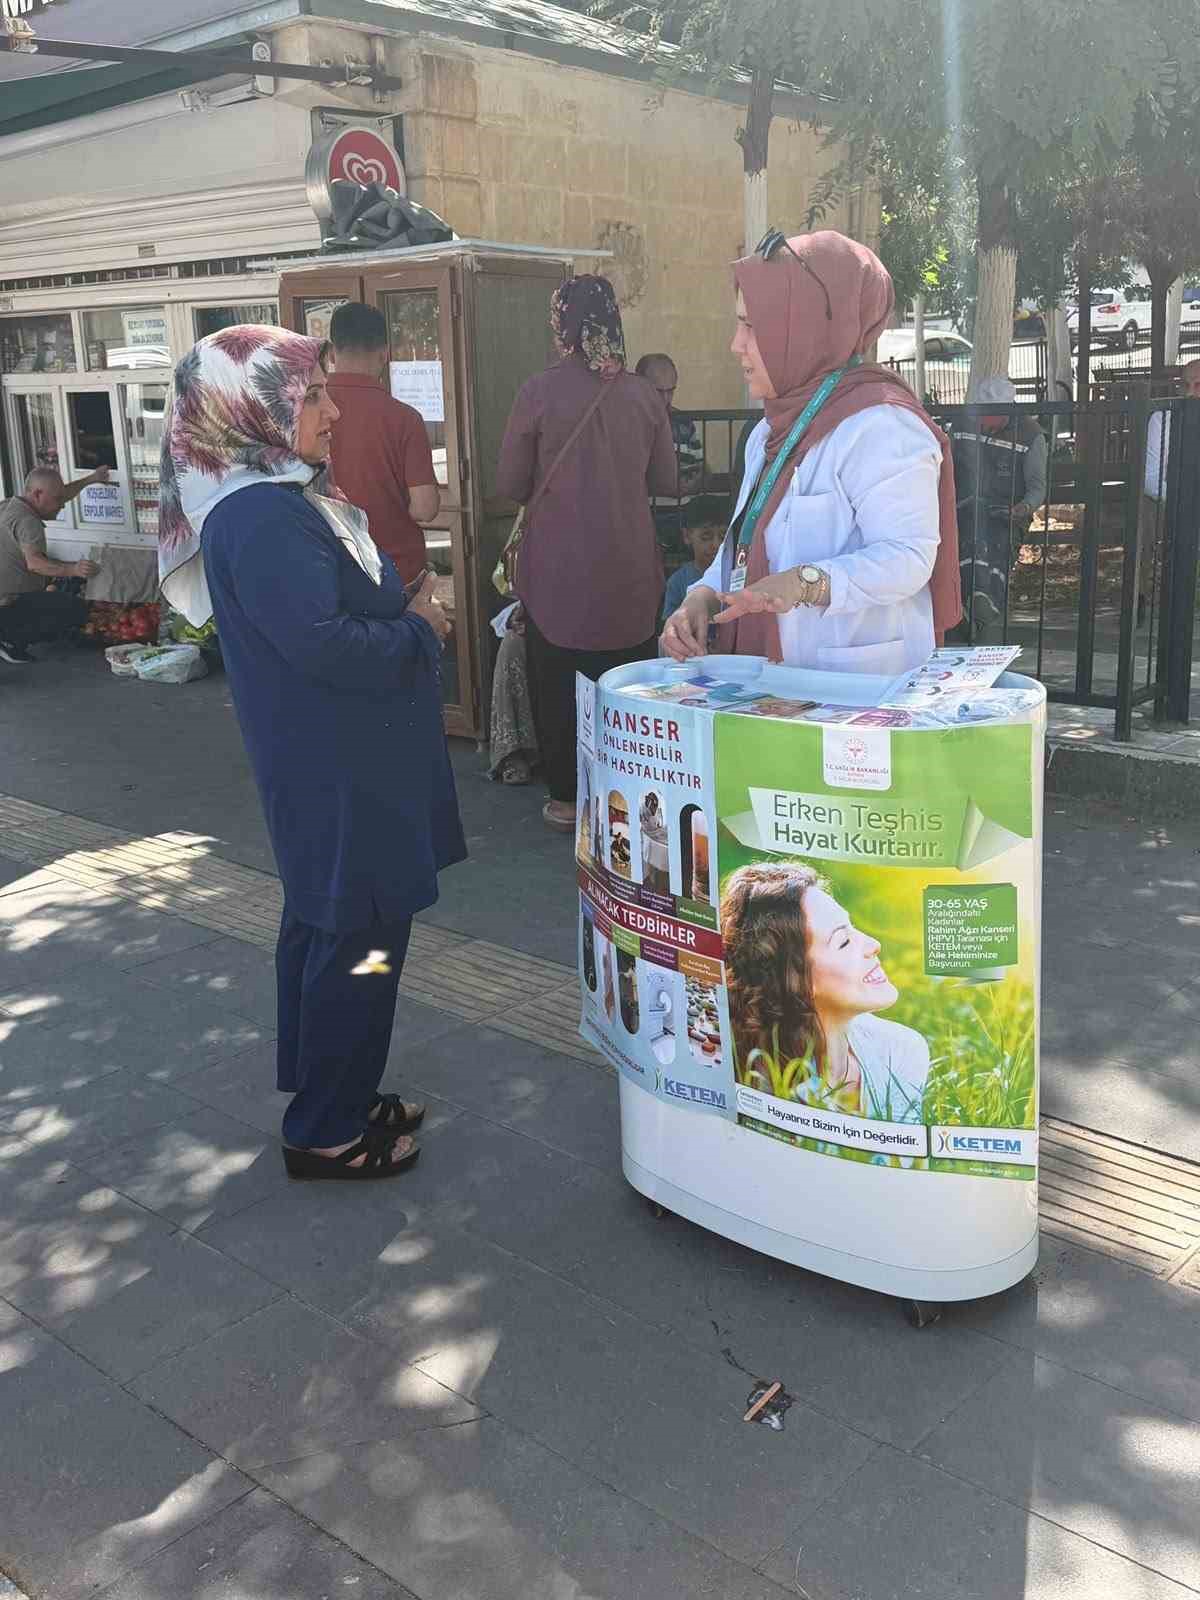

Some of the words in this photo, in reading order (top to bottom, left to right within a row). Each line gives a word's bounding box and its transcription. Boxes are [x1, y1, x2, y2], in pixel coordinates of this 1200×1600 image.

[602, 705, 680, 742] KANSER
[603, 732, 683, 763] ÖNLENEBİLİR
[611, 756, 702, 789] HASTALIKTIR
[774, 794, 842, 826] Erken
[851, 804, 943, 836] Teşhis
[774, 822, 838, 851] Hayat
[845, 832, 943, 857] Kurtarır.
[928, 899, 961, 908] 30-65
[964, 898, 988, 910] YAŞ
[620, 907, 696, 947] TEDBİRLER
[928, 926, 956, 934] Rahim
[981, 924, 1015, 933] Kanseri
[928, 934, 955, 943] (HPV)
[928, 943, 960, 951] KETEM
[928, 951, 946, 959] Aile
[947, 951, 998, 959] Hekiminize
[664, 1078, 726, 1106] KETEM
[767, 1104, 811, 1127] Hayatınız
[812, 1117, 841, 1133] Bizim
[842, 1121, 860, 1138] İçin
[863, 1129, 919, 1147] Değerlidir.
[953, 1136, 1022, 1152] KETEM
